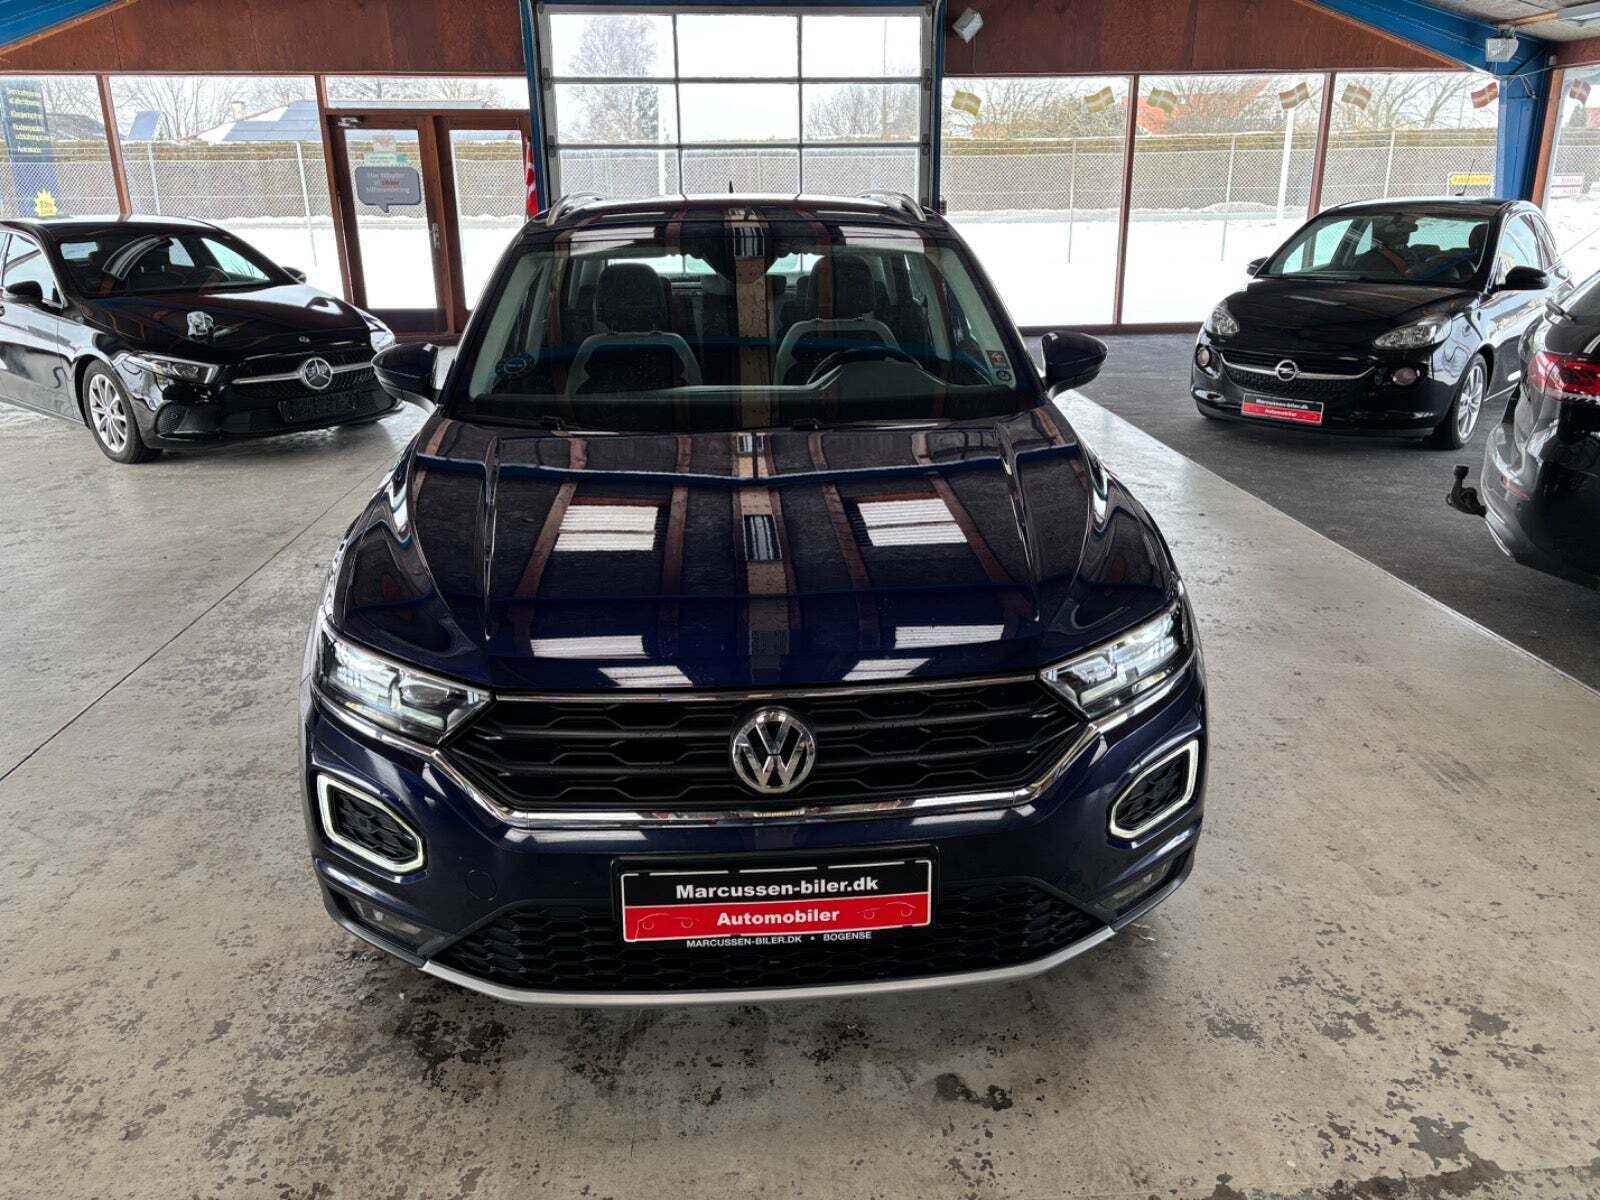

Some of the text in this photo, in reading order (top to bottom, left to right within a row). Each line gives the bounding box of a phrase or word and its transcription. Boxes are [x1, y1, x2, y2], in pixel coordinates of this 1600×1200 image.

[676, 877, 879, 899] Marcussen-biler.dk
[716, 909, 840, 927] Automobiler
[686, 931, 872, 949] MARCUSSEN-BILER.DK BOGENSE
